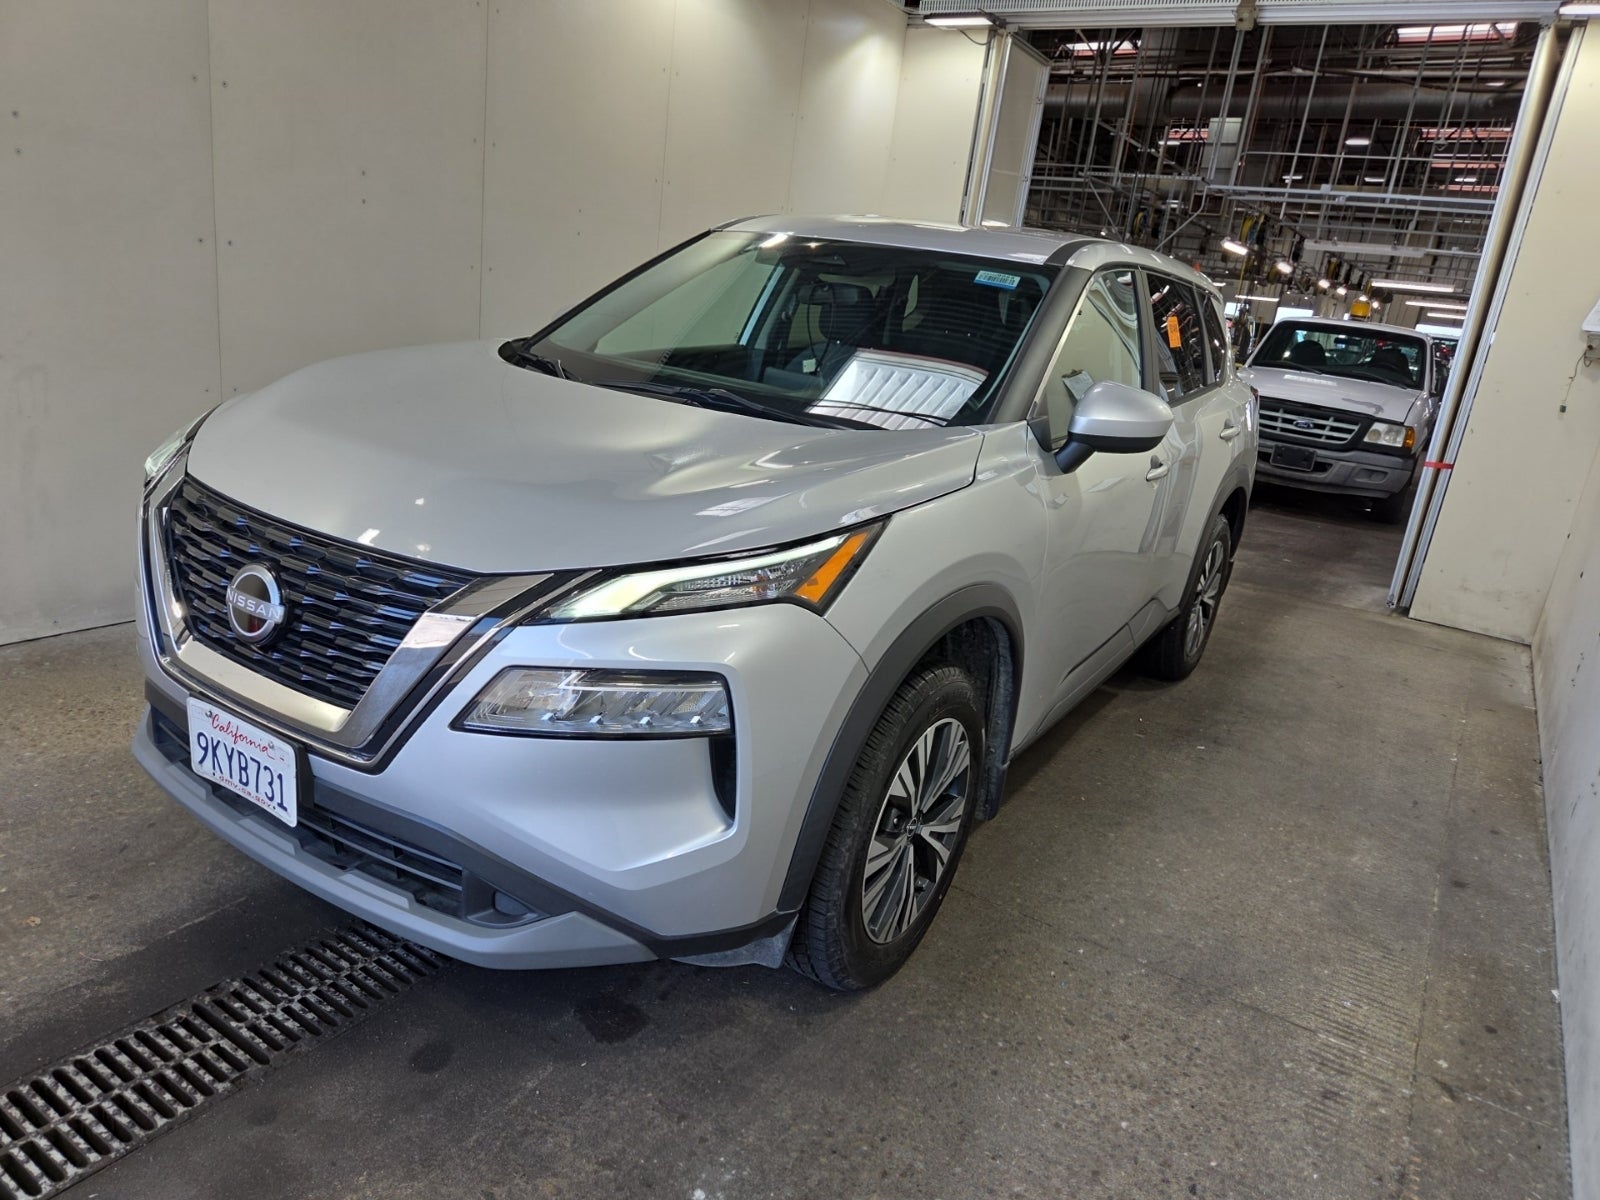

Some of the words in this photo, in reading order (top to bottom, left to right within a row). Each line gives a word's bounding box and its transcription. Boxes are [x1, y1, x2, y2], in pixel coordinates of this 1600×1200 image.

[226, 587, 281, 619] NISSAN
[211, 713, 276, 760] California
[196, 731, 288, 812] 9KYB731
